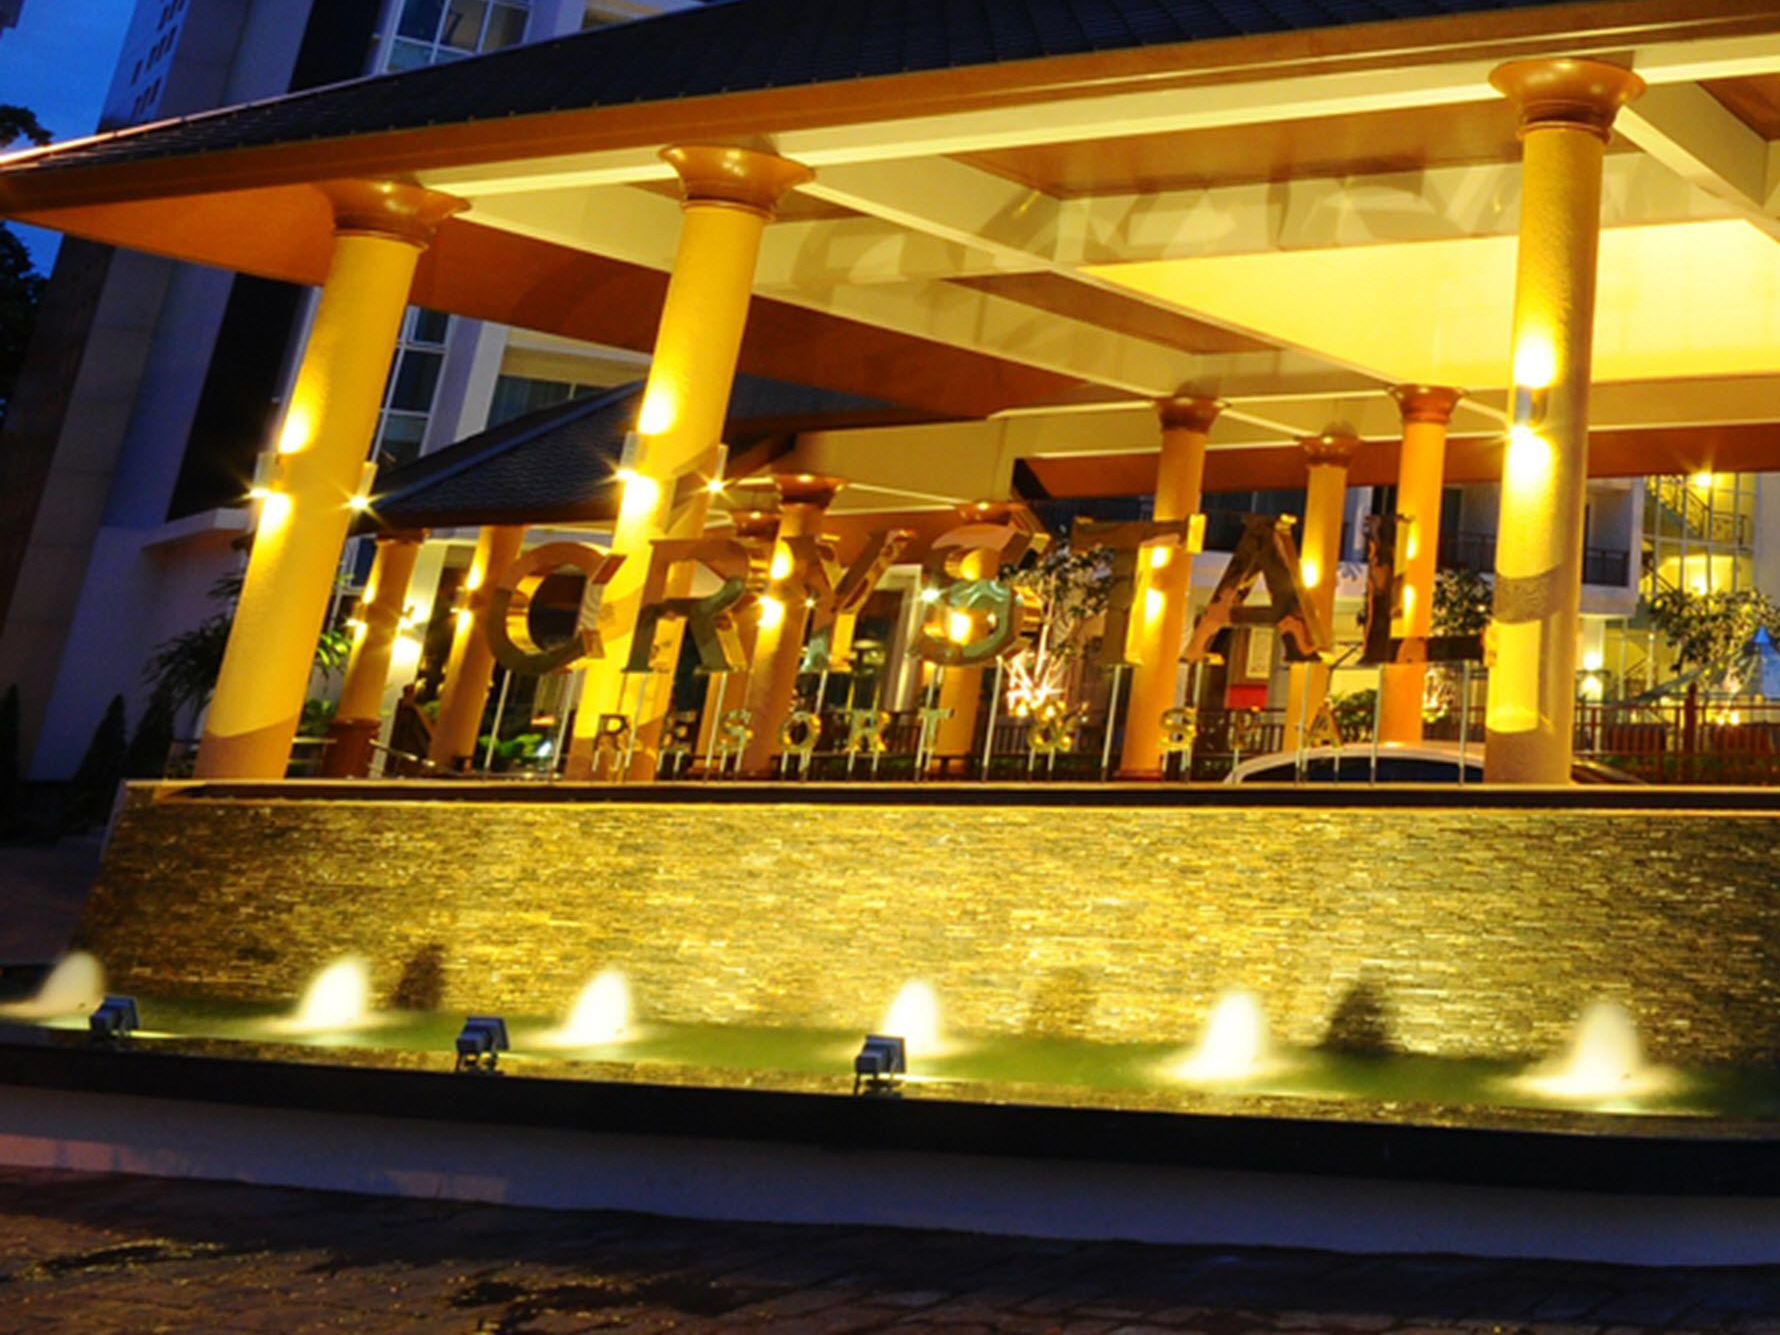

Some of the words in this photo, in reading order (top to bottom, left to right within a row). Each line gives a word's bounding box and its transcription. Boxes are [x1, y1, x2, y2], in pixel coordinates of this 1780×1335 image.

[486, 513, 1496, 674] CRYSTAL
[594, 708, 955, 754] RESORT
[1157, 699, 1342, 751] SPA
